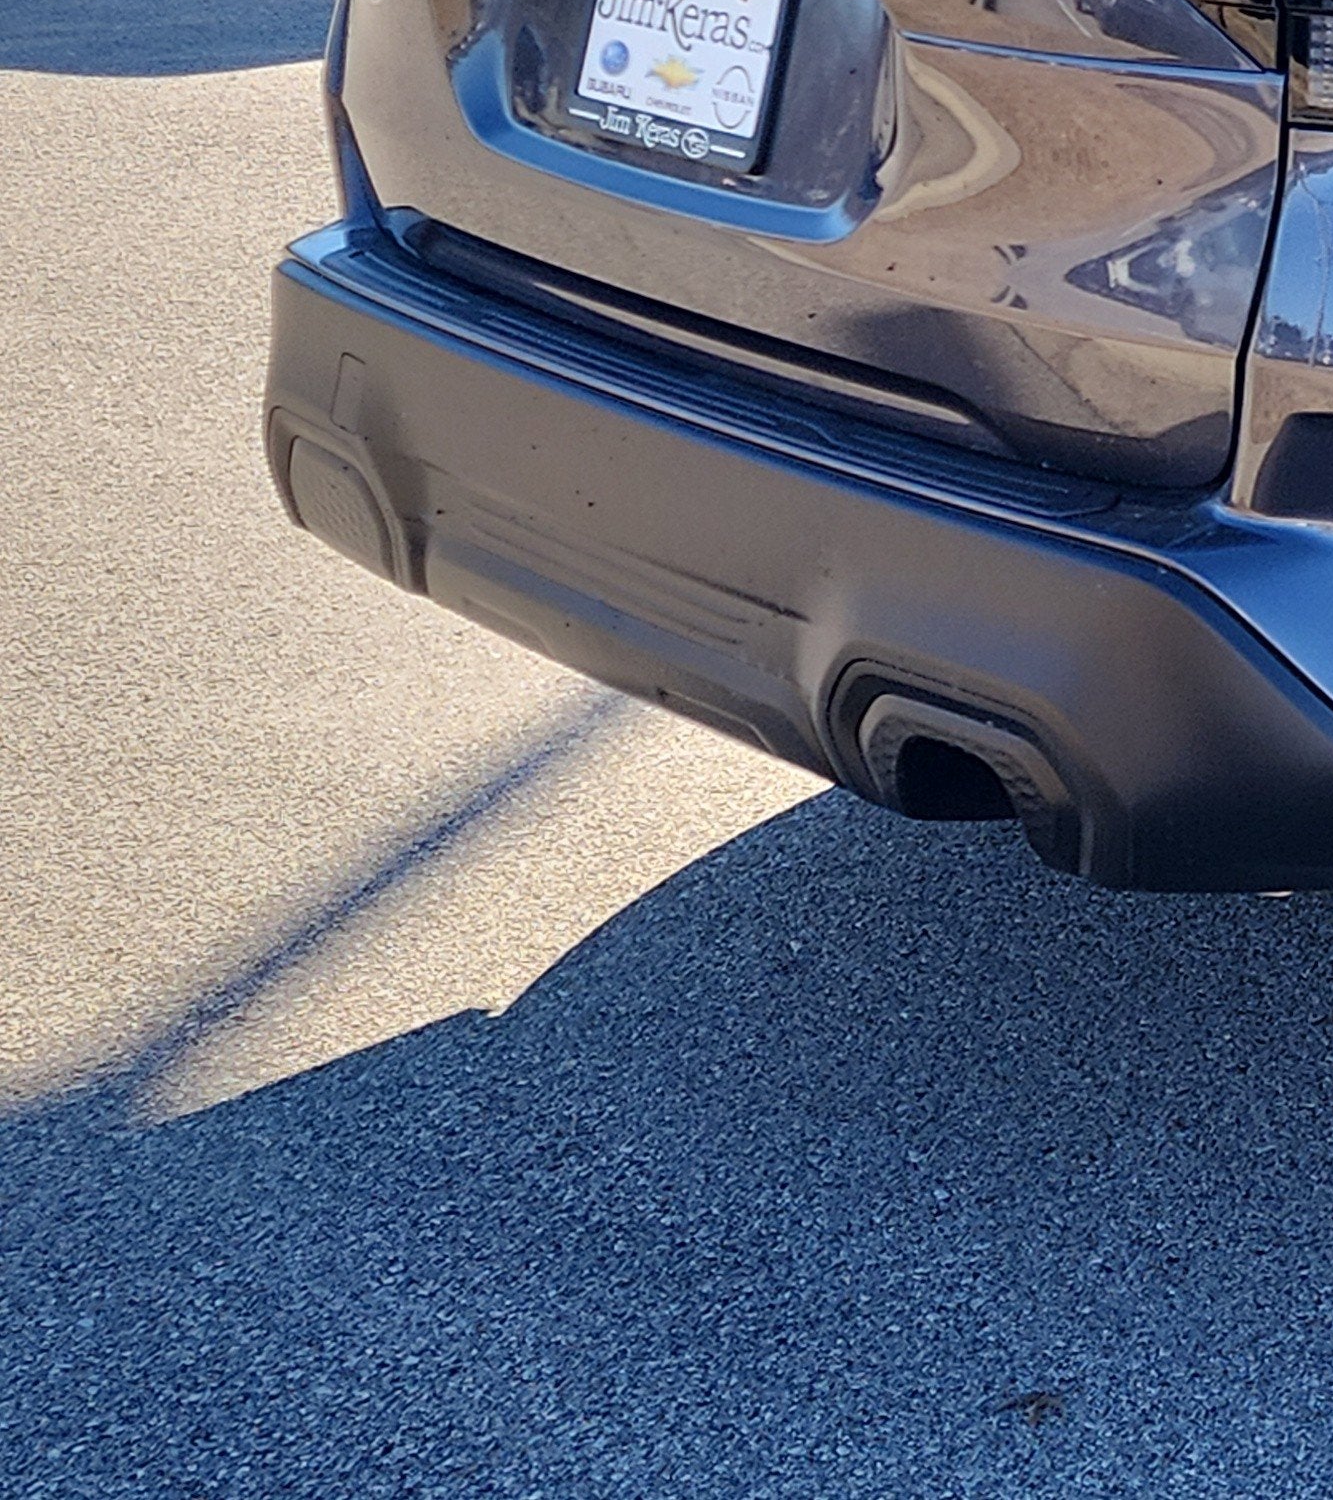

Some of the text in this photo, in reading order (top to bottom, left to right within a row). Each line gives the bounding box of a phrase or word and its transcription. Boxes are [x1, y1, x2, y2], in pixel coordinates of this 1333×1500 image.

[586, 76, 632, 100] SUBARU
[599, 105, 682, 149] Jim Keras
